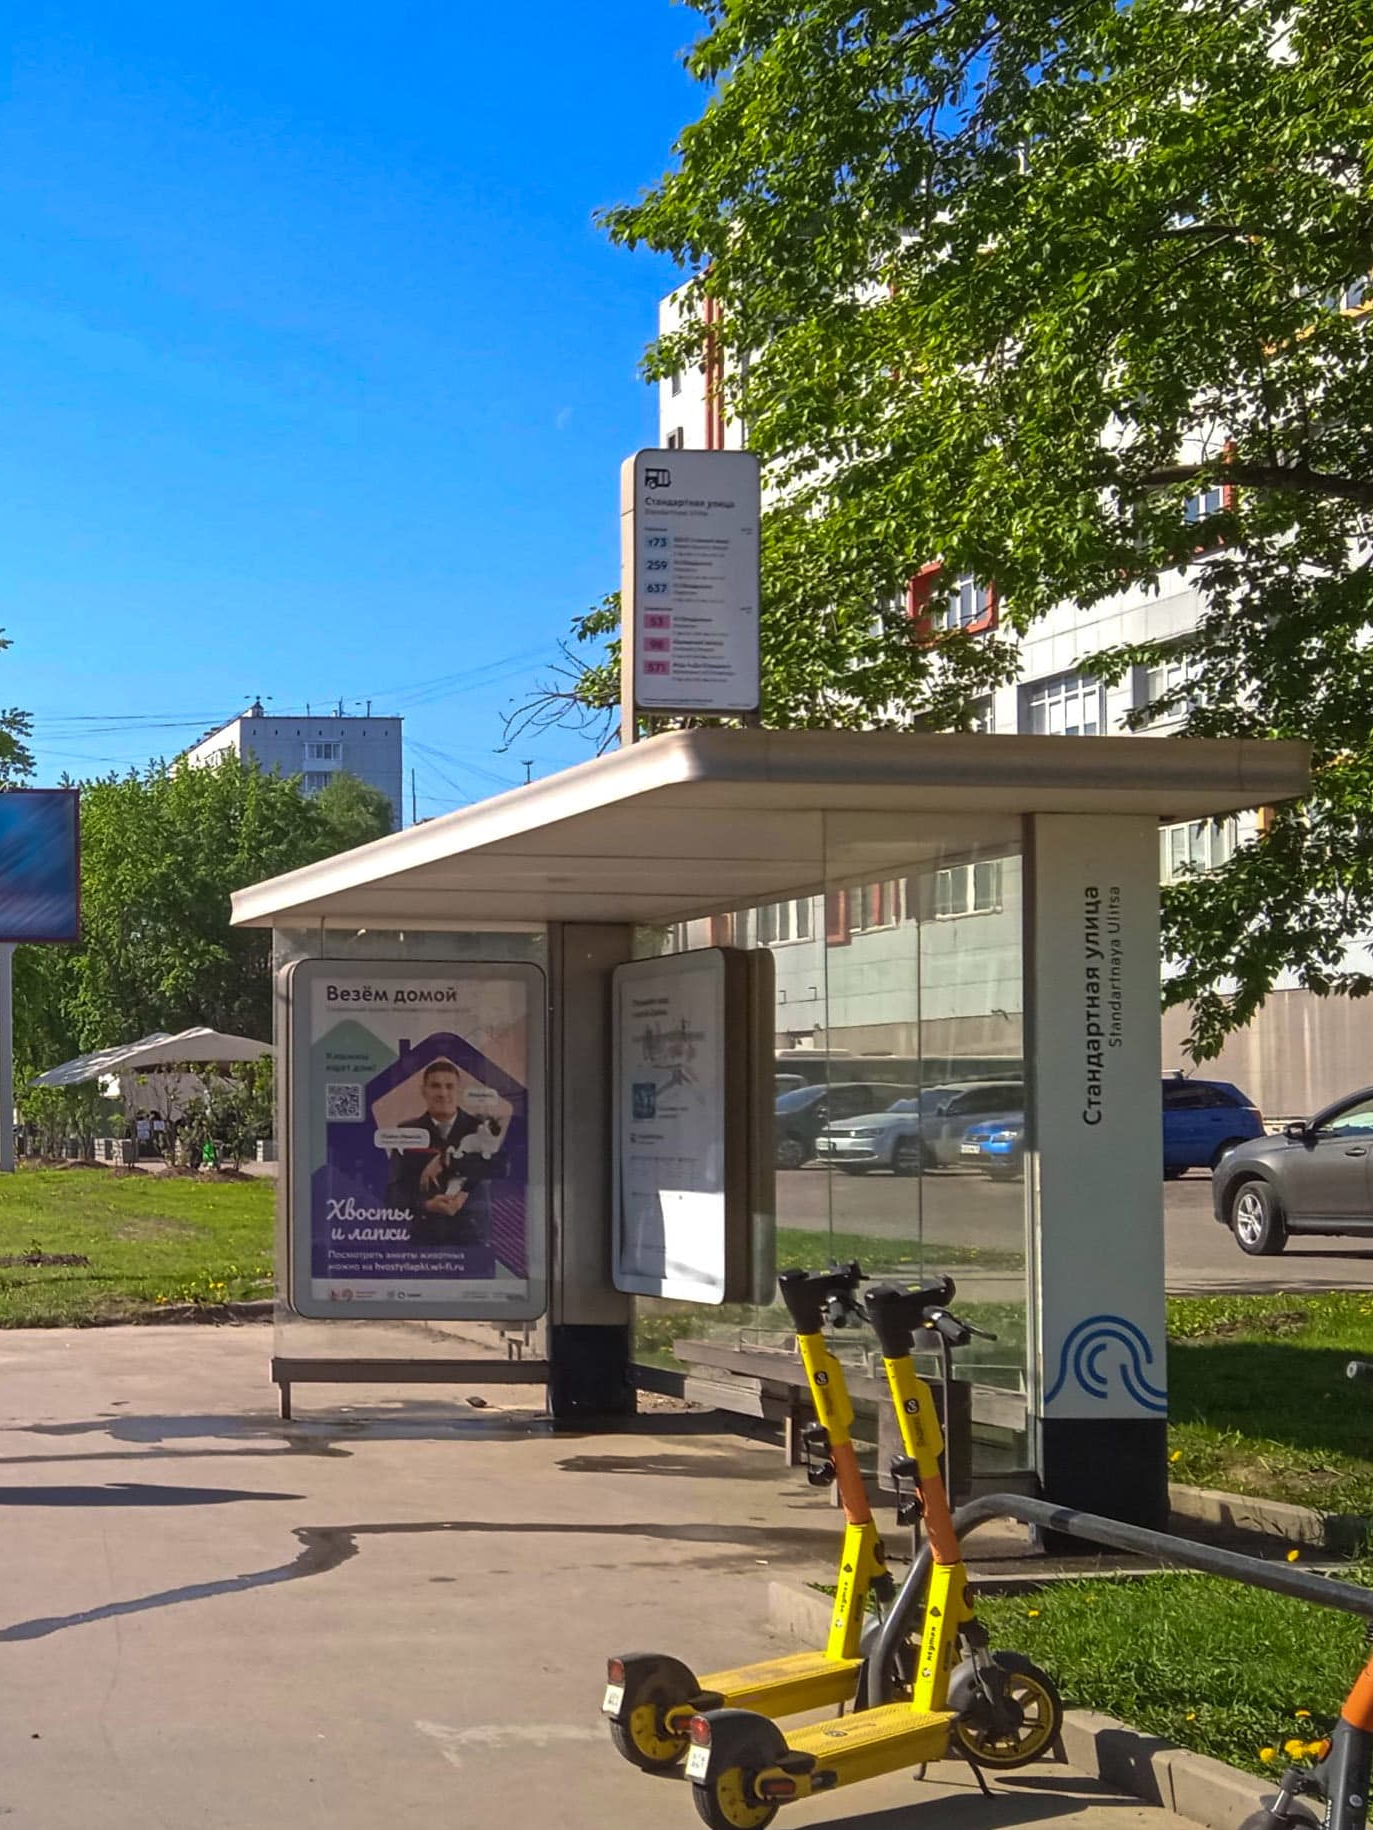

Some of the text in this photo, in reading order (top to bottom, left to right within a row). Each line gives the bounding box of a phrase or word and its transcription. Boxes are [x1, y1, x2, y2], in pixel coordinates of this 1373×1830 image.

[646, 560, 668, 570] 259
[646, 583, 668, 593] 637
[1107, 885, 1124, 1047] Standartnaya Ulitsa
[326, 985, 457, 1004] Везём домой
[1083, 886, 1105, 1125] Стандартная улица
[326, 1197, 414, 1222] Хвосты
[331, 1227, 411, 1241] и лапки
[328, 1250, 384, 1260] Посмотреть
